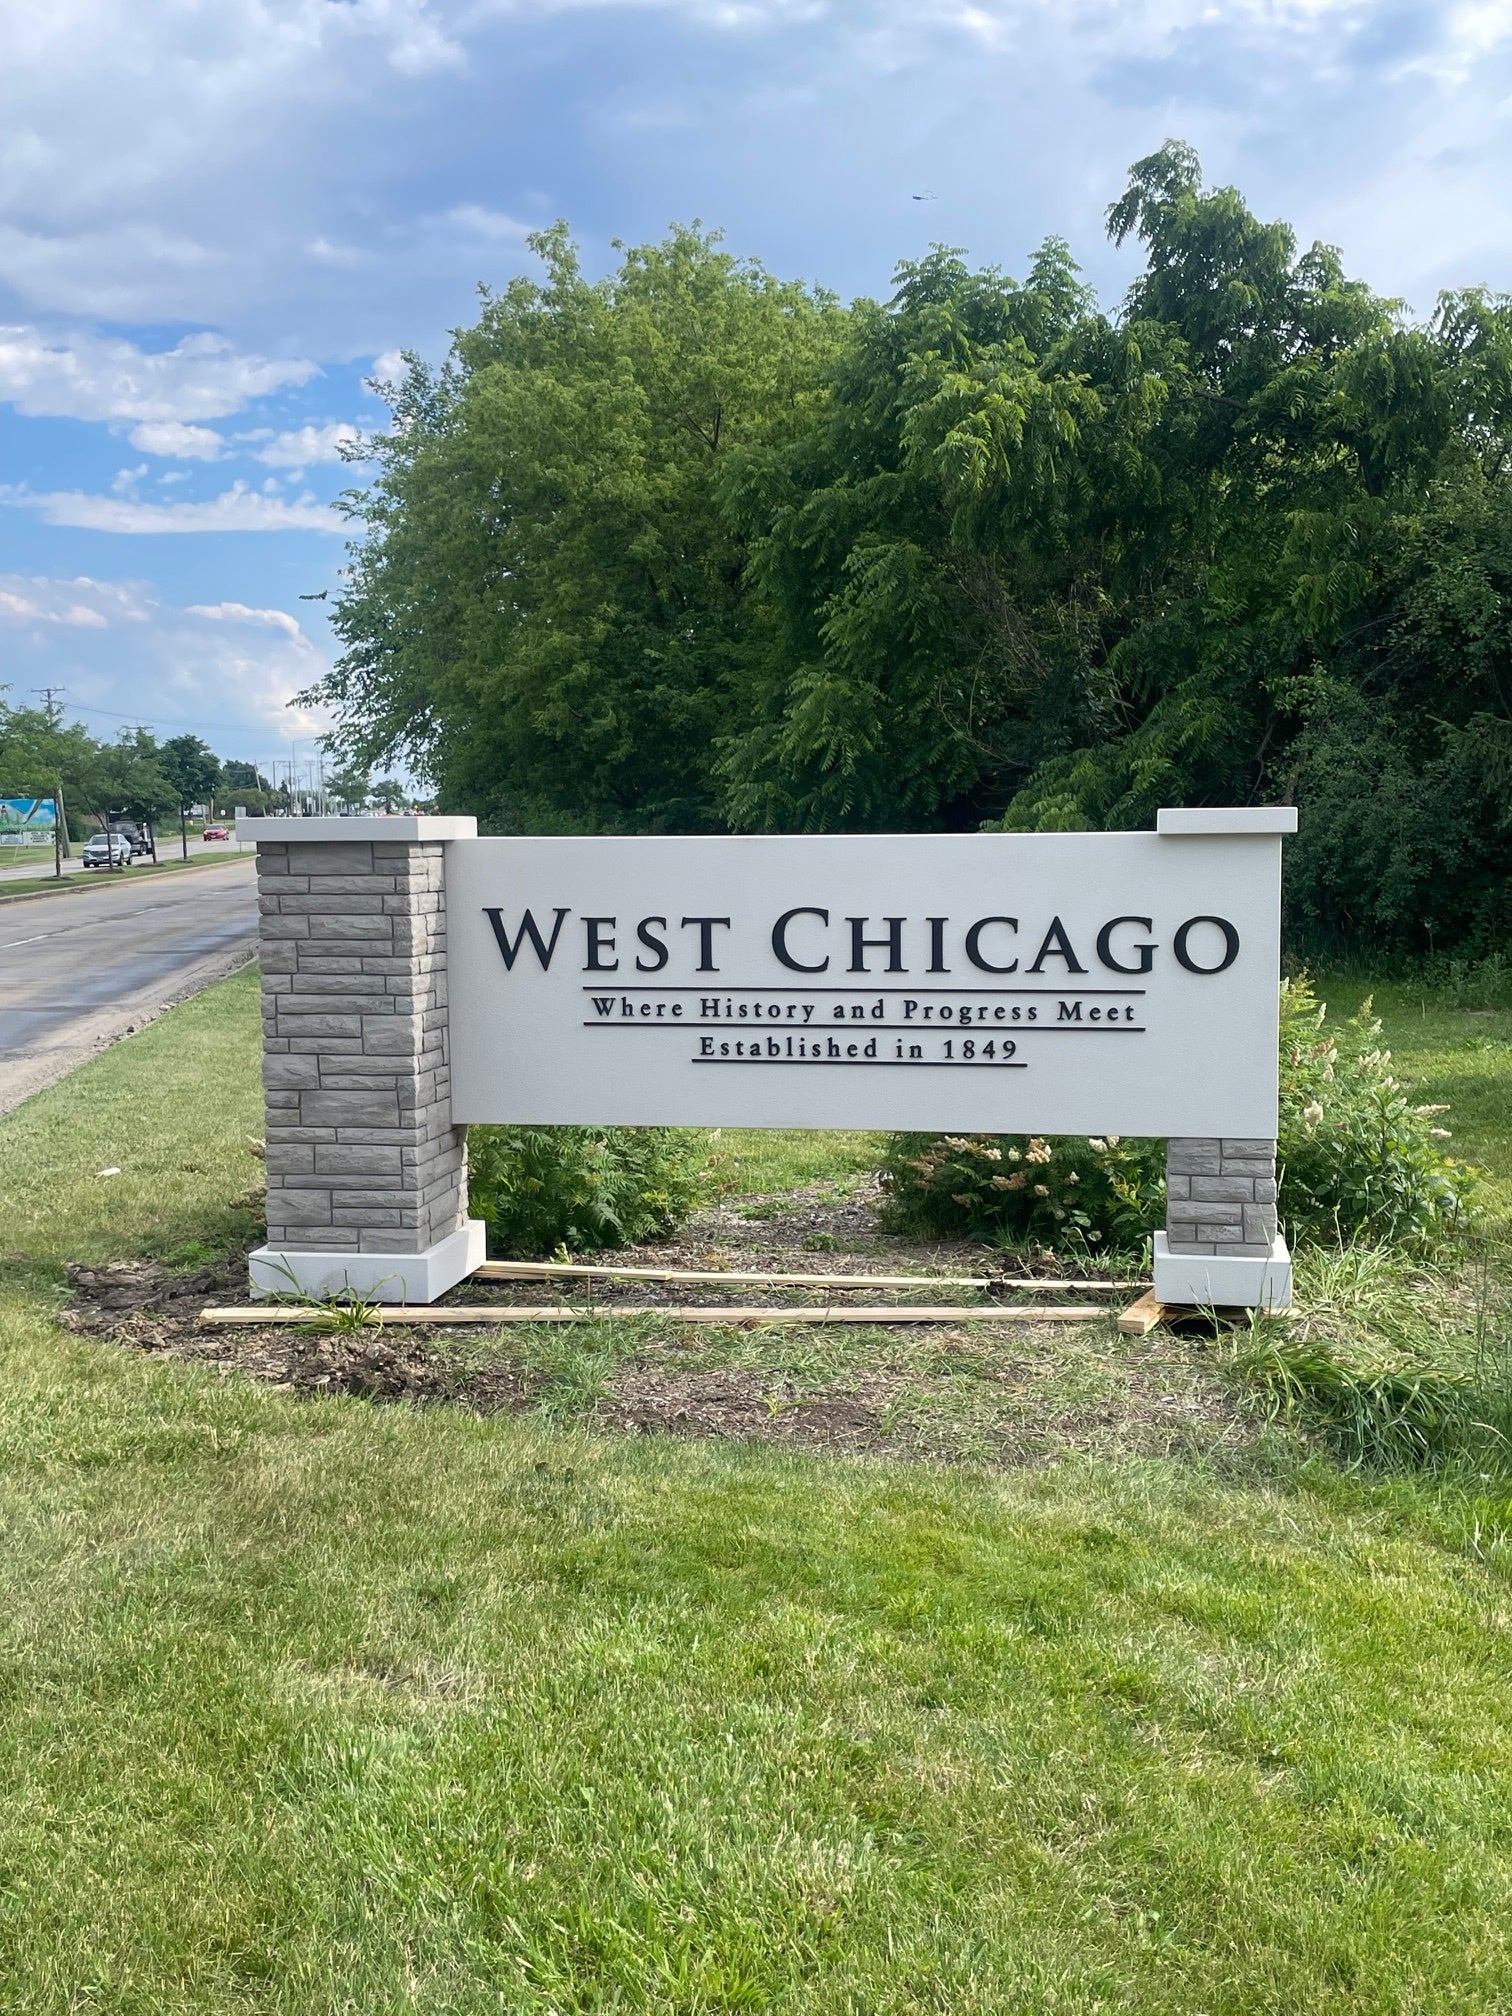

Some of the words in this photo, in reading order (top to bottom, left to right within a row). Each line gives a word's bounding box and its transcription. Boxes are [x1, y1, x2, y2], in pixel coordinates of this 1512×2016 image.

[481, 907, 732, 973] WEST
[771, 906, 1241, 976] CHICAGO
[590, 996, 684, 1018] Where
[699, 997, 817, 1025] History
[832, 998, 886, 1020] and
[903, 999, 1039, 1026] Progress
[1056, 1000, 1136, 1022] Meet
[699, 1036, 879, 1058] Established
[895, 1037, 925, 1060] in
[942, 1039, 1018, 1061] 1849
